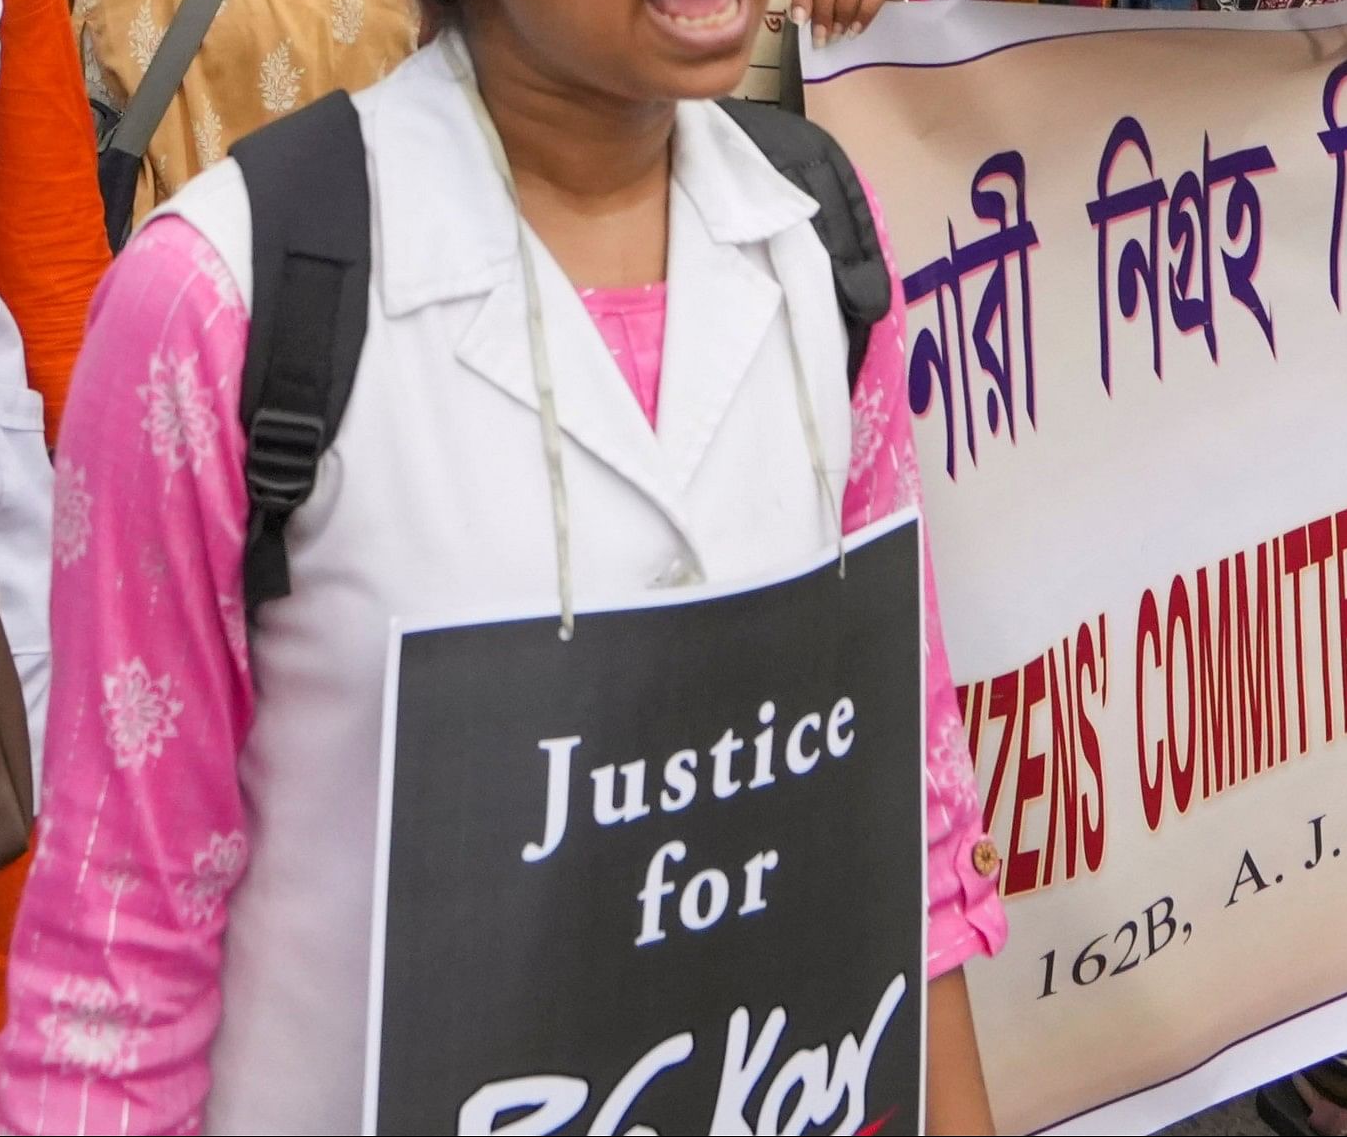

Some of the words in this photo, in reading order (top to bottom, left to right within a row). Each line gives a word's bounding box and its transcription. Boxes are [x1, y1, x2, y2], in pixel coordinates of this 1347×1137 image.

[904, 150, 1041, 482] নারী
[1087, 116, 1277, 399] নিগ্রহ
[521, 696, 855, 862] Justice
[955, 613, 1107, 898] IZENS'
[634, 839, 779, 947] for
[1036, 895, 1193, 1000] 162B,
[1224, 849, 1283, 908] A.
[1304, 815, 1341, 870] J.
